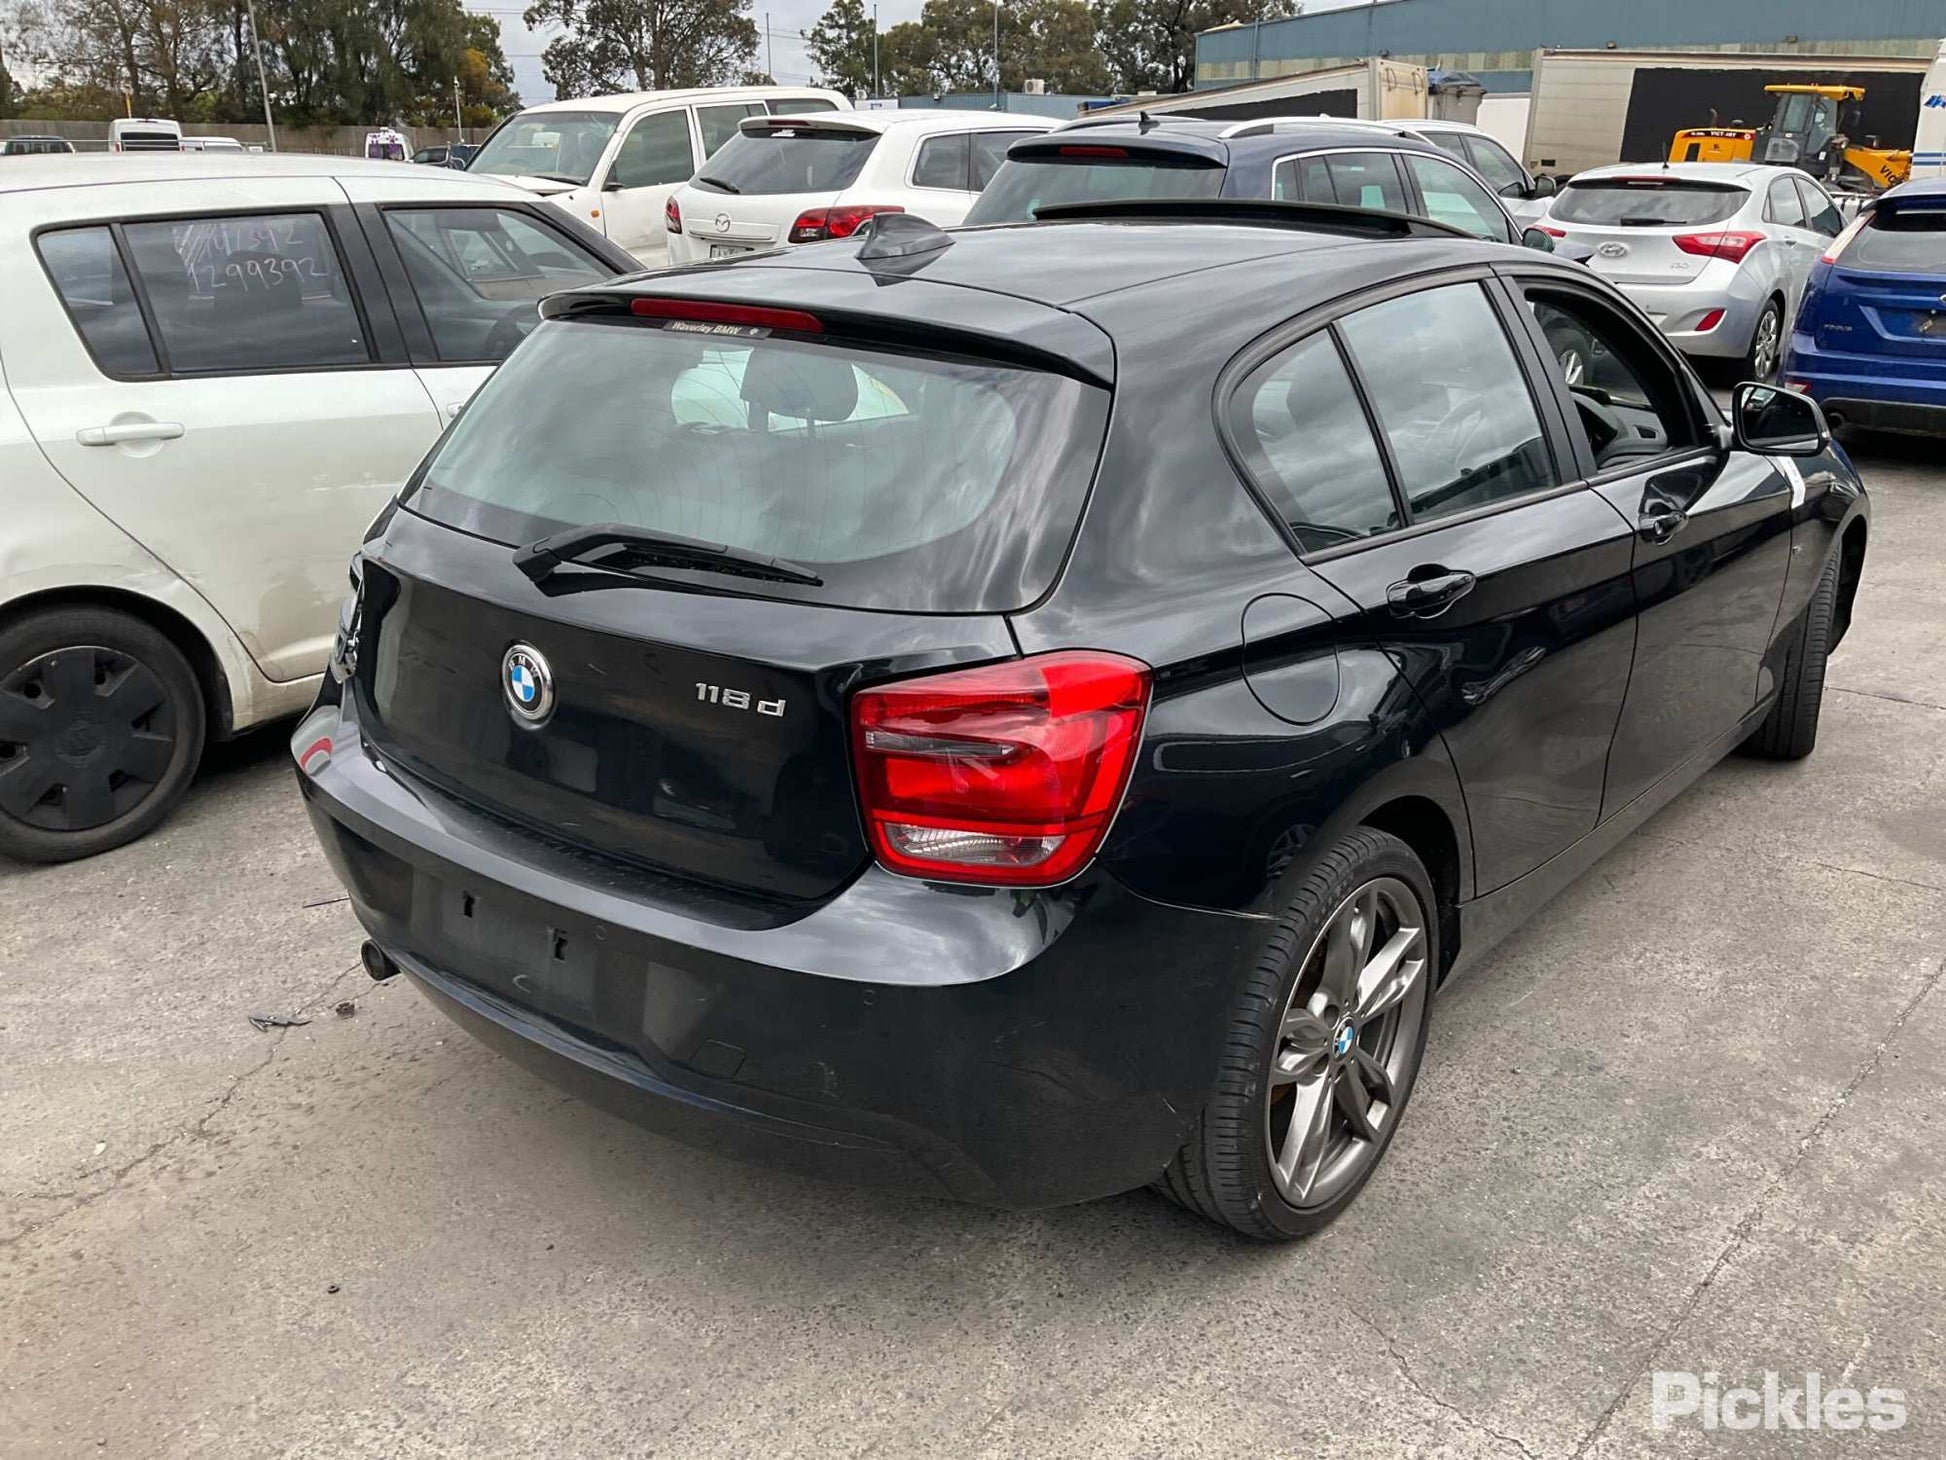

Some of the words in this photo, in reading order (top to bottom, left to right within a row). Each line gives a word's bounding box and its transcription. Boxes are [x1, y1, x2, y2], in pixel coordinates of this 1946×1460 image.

[187, 257, 328, 293] 1299392
[672, 321, 713, 334] Waverley
[713, 325, 742, 335] BMW
[508, 655, 539, 678] BMW
